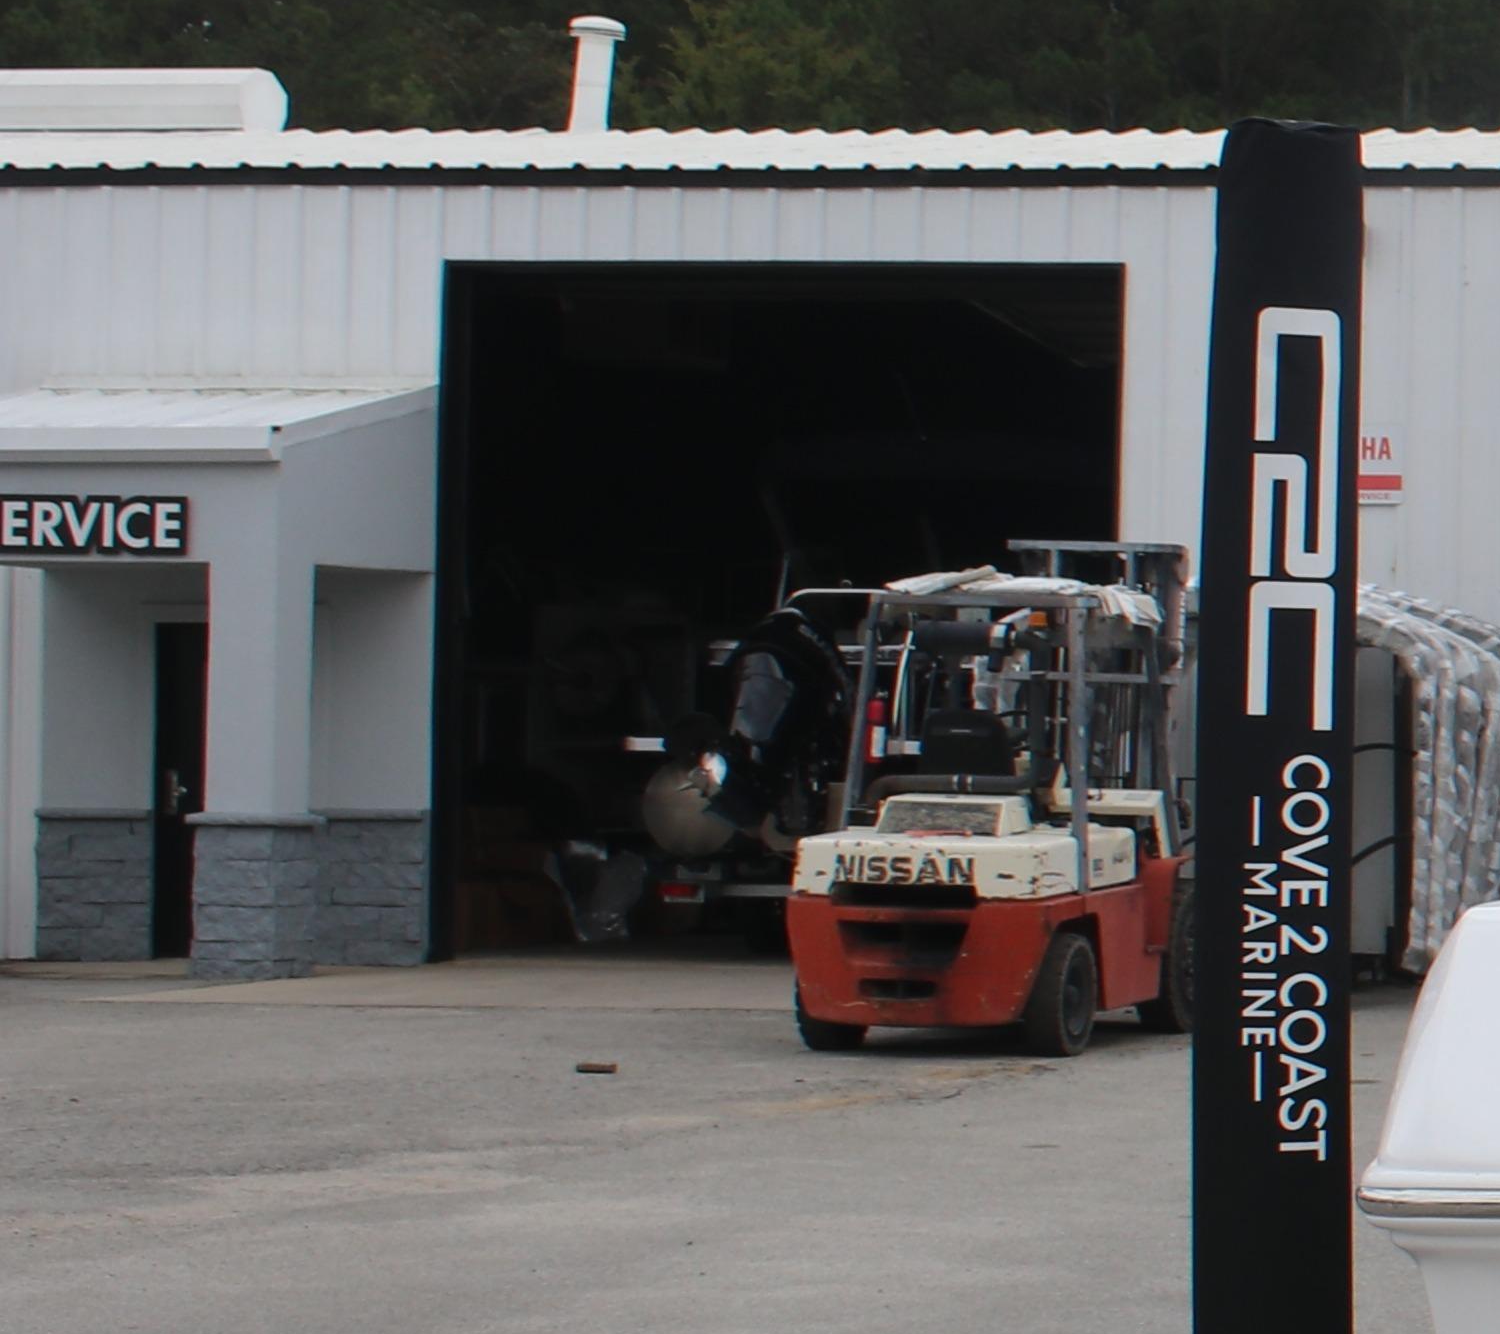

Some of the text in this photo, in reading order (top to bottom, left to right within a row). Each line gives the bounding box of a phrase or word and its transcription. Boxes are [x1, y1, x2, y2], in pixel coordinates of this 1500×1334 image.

[1, 500, 182, 549] ERVICE
[1246, 306, 1341, 732] C2C
[835, 852, 976, 884] NISSAN
[1242, 862, 1278, 1046] MARINE
[1279, 754, 1331, 1161] COVE 2 COAST
